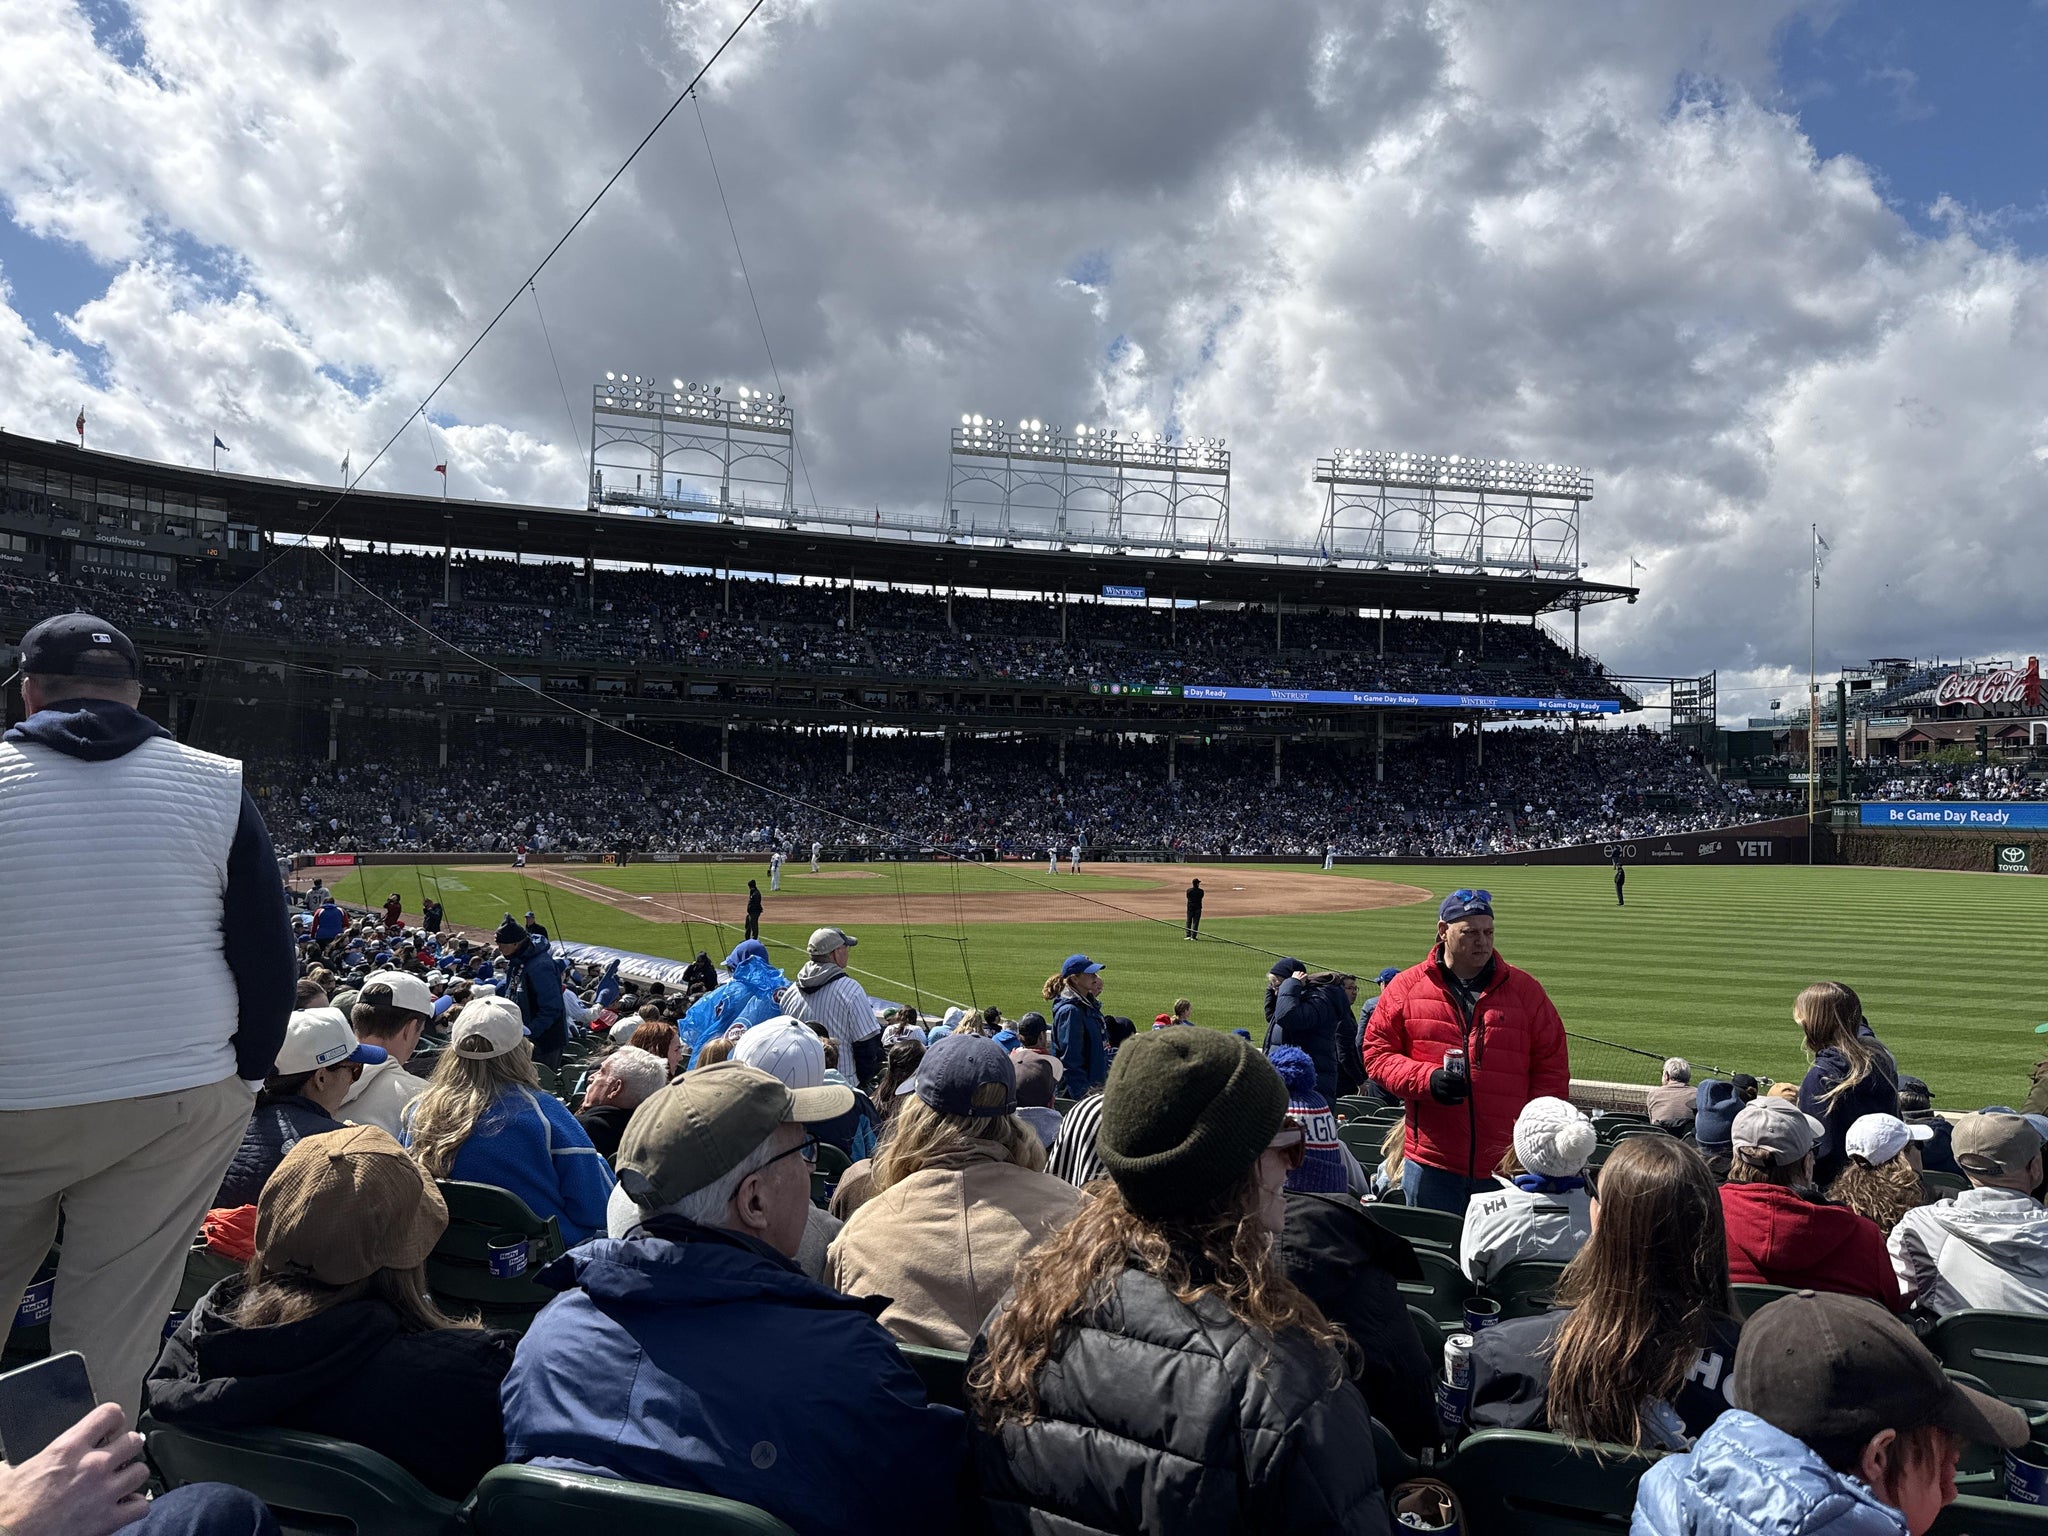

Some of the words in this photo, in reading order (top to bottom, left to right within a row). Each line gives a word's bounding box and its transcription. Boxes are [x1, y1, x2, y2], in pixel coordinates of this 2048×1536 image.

[96, 533, 139, 547] Southwest
[139, 572, 167, 582] CLUB
[1106, 586, 1143, 597] WINTRUST
[1103, 685, 1108, 693] 1
[1190, 688, 1203, 698] Day
[1205, 689, 1227, 698] Ready
[1271, 690, 1309, 699] WINTRUST
[1353, 694, 1363, 702] Be
[1364, 695, 1383, 703] Game
[1384, 696, 1397, 704] Day
[1398, 696, 1419, 705] Ready
[1548, 701, 1567, 709] Game
[1567, 702, 1580, 710] Day
[1580, 702, 1600, 711] Ready
[1833, 808, 1859, 819] Harvey
[1889, 809, 1904, 821] Be
[1906, 810, 1941, 822] Game
[1944, 810, 1968, 824] Day
[1971, 809, 2010, 825] Ready
[1736, 841, 1772, 857] YETI
[1998, 864, 2029, 872] TOYOTA
[313, 895, 322, 905] 31
[1483, 1197, 1508, 1216] HH
[23, 1300, 48, 1312] Hefty
[2011, 1485, 2040, 1503] Hefty
